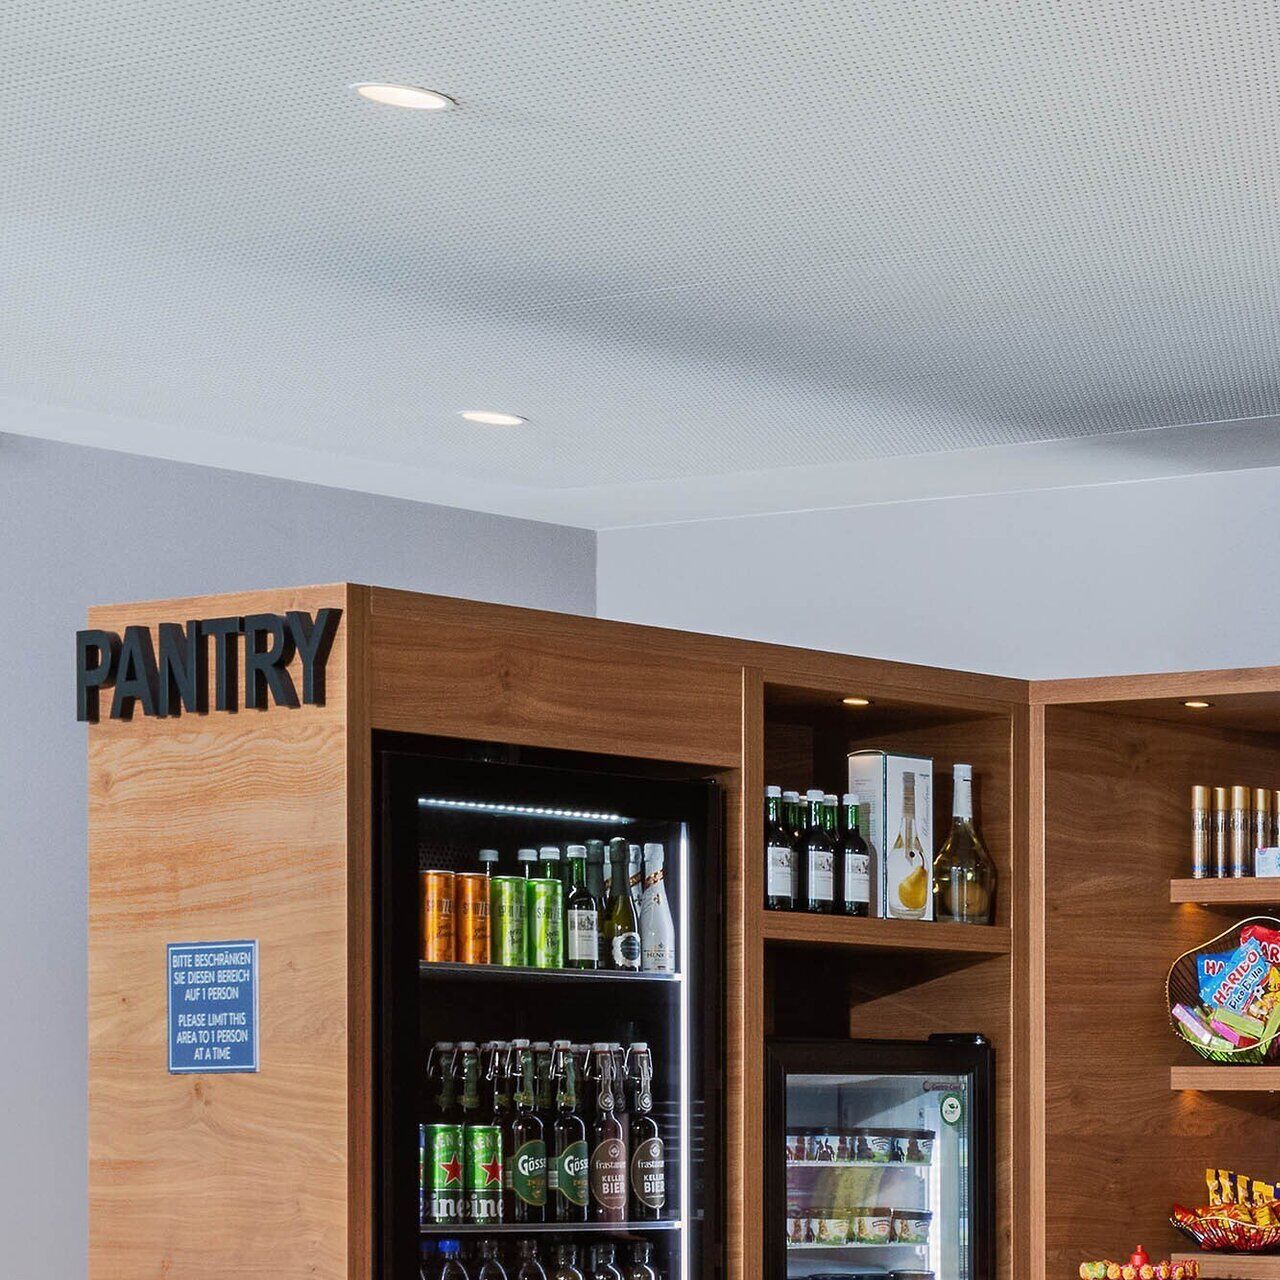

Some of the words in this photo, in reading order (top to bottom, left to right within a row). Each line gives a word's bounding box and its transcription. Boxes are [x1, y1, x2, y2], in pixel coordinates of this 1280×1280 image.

[76, 608, 343, 724] PANTRY
[172, 954, 192, 968] BITTE
[194, 951, 251, 967] BESCHRÄNKEN
[173, 971, 186, 984] SIE
[187, 970, 215, 984] DIESEN
[217, 969, 250, 983] BEREICH
[1212, 948, 1260, 1006] HARIBO
[184, 988, 202, 1001] AUF
[207, 987, 239, 1000] PERSON
[178, 1014, 206, 1027] PLEASE
[208, 1013, 227, 1026] LIMIT
[228, 1012, 246, 1026] THIS
[176, 1031, 198, 1044] AREA
[199, 1030, 210, 1043] TO
[216, 1029, 248, 1043] PERSON
[193, 1047, 204, 1060] AT
[205, 1047, 212, 1060] A
[212, 1046, 231, 1060] TIME
[602, 1182, 626, 1195] BIER
[643, 1180, 665, 1194] BIER
